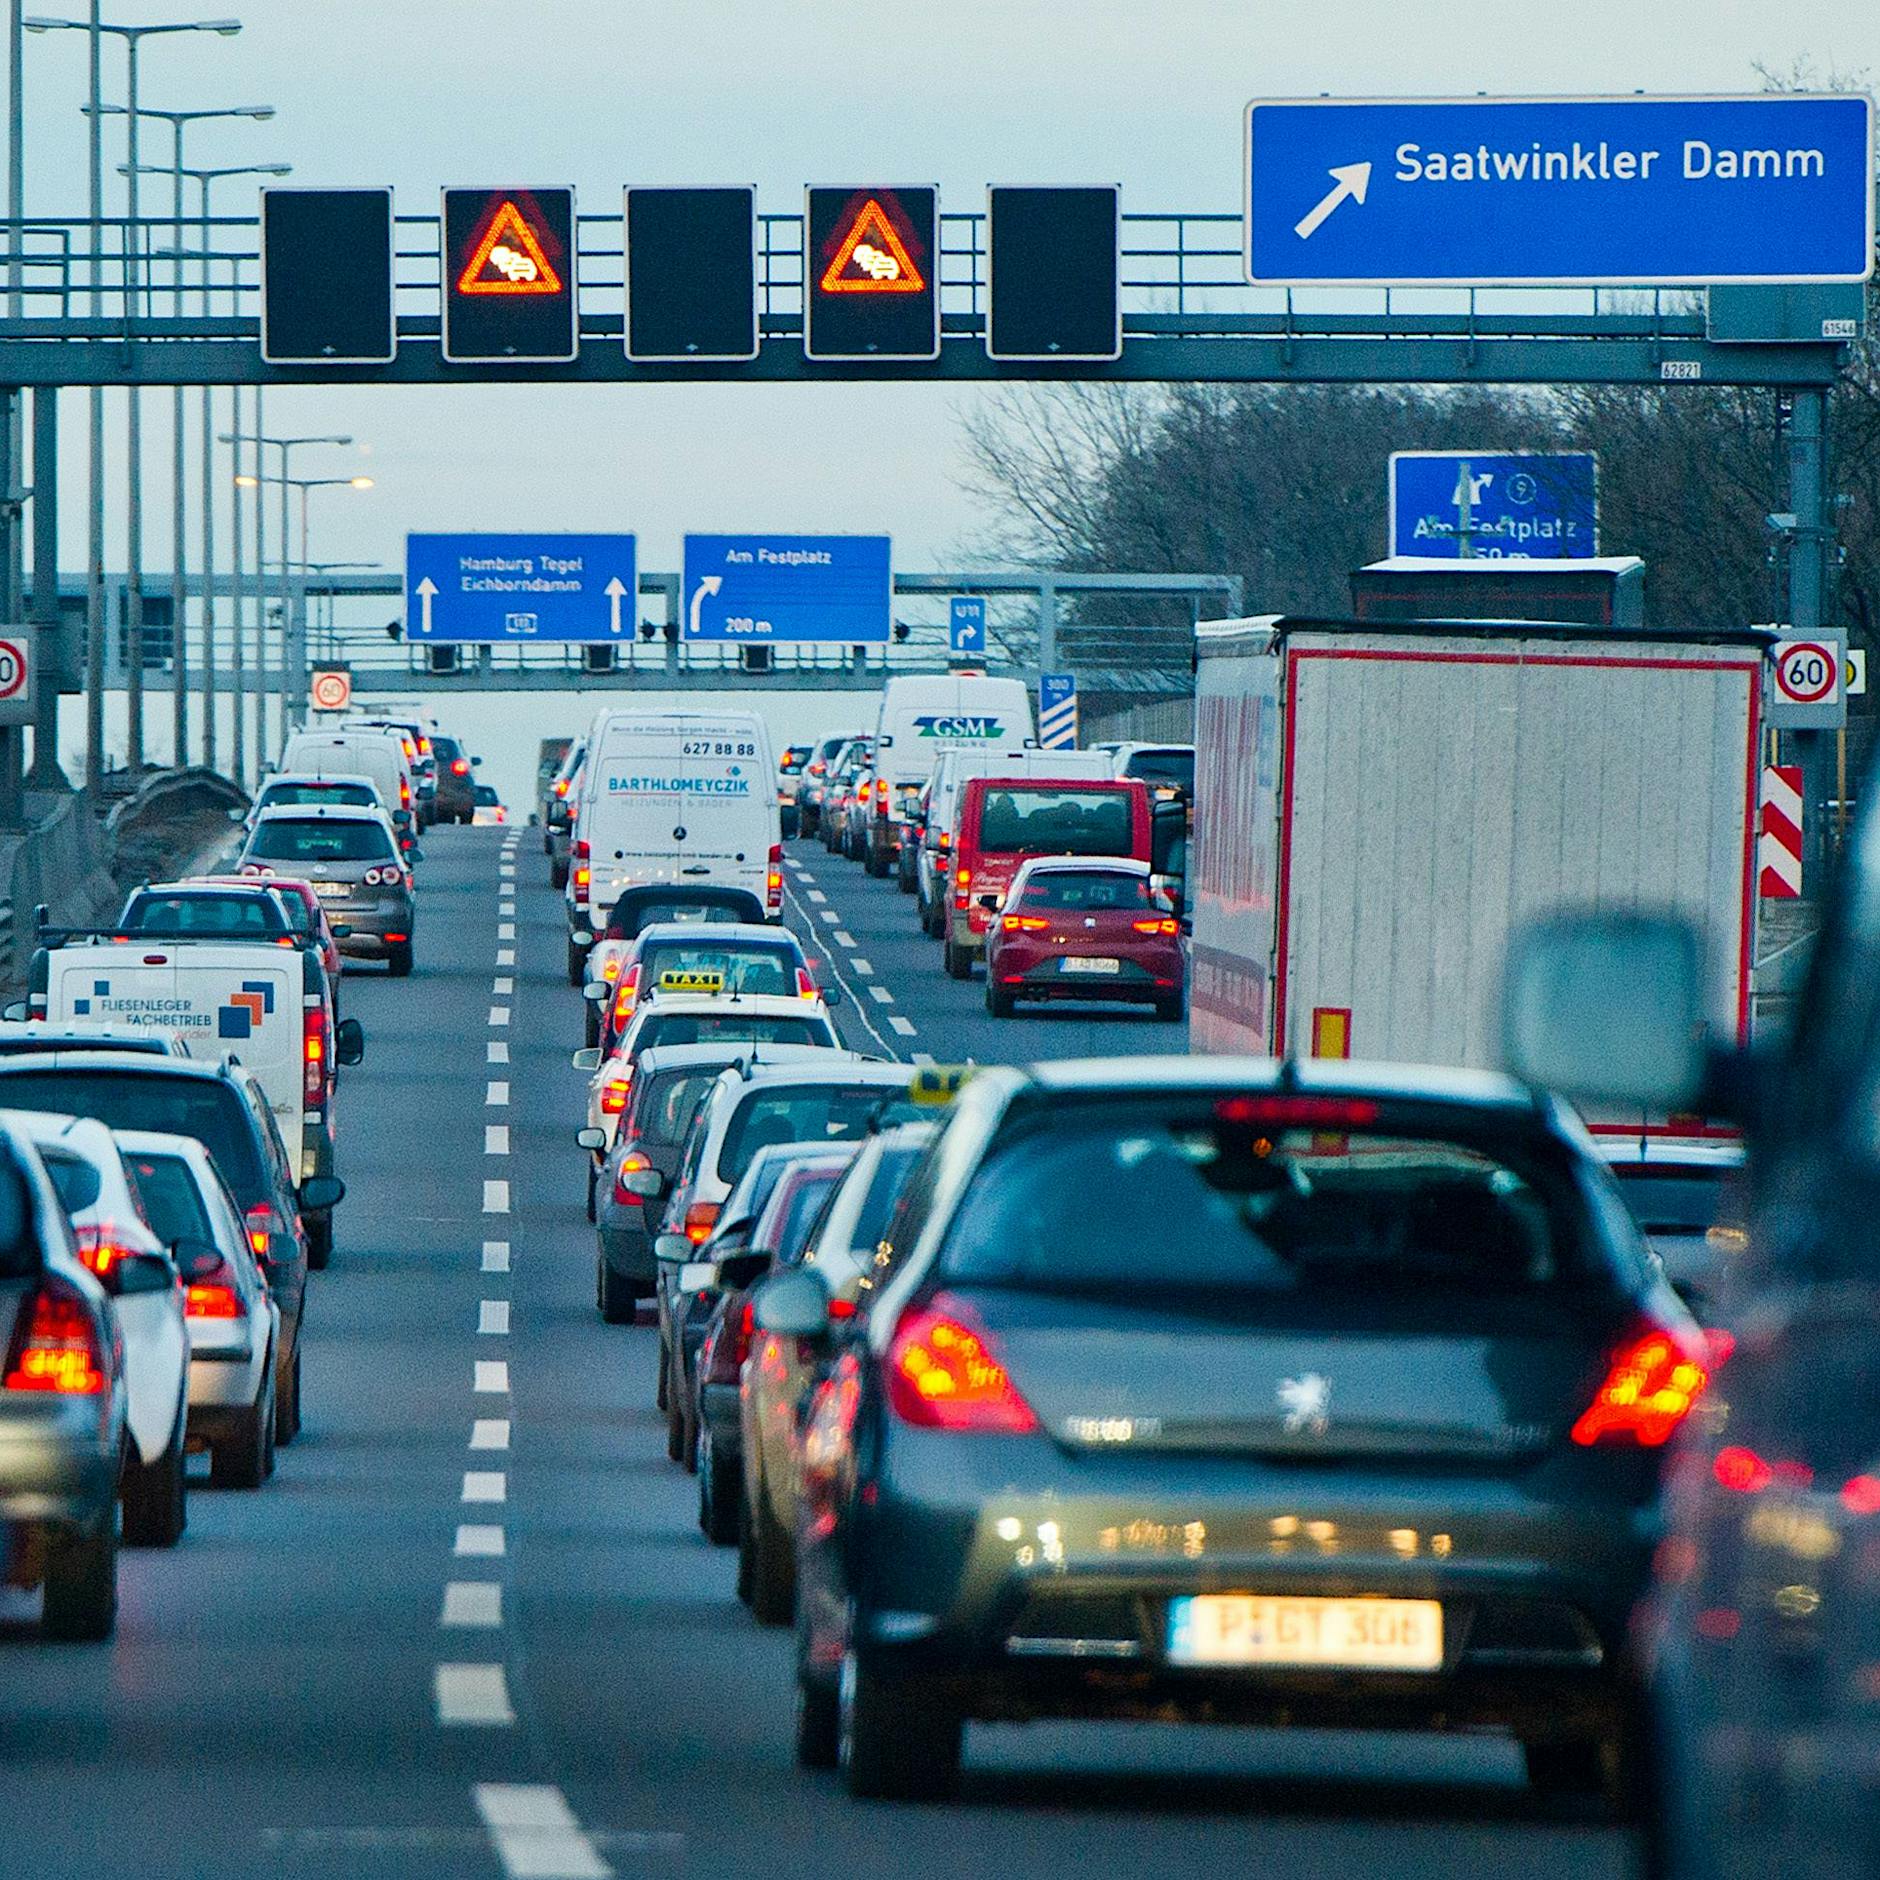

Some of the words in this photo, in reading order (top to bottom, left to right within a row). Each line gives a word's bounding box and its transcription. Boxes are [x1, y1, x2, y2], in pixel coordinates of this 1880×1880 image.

[1395, 142, 1660, 182] Saatwinkler
[1682, 140, 1824, 179] Damm
[1663, 364, 1699, 378] 62821
[460, 556, 533, 575] Hamburg
[540, 555, 583, 575] Tegel
[726, 549, 754, 563] Am
[758, 548, 832, 566] Festplatz
[725, 617, 754, 633] 200
[755, 621, 773, 633] m
[1790, 659, 1823, 686] 60
[322, 682, 341, 698] 60
[932, 718, 986, 737] GSM
[683, 743, 711, 755] 627
[714, 743, 733, 756] 88
[736, 743, 756, 757] 88
[608, 777, 749, 793] BARTHLOMEYCZIK
[102, 999, 192, 1012] FLIESENLEGER
[126, 1013, 212, 1027] FACHBETRIEB
